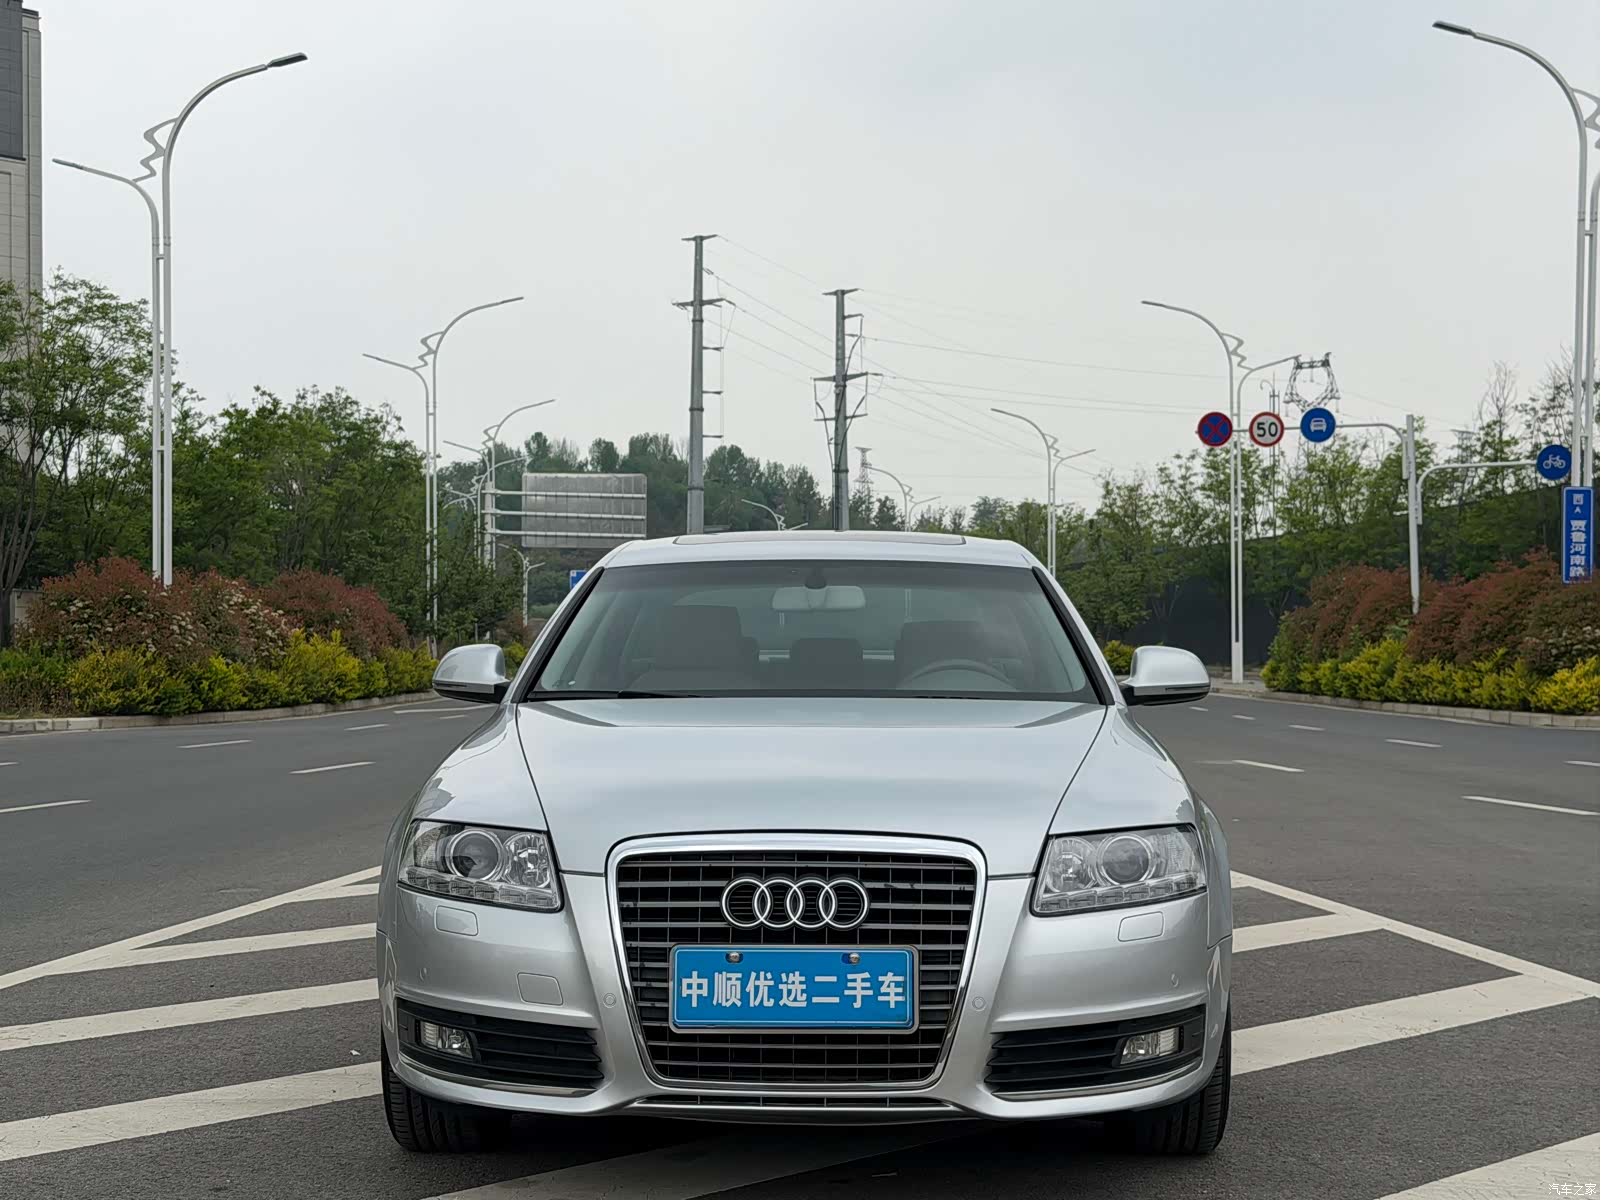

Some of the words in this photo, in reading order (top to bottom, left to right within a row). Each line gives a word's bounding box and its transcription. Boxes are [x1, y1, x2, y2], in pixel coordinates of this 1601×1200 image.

[1257, 422, 1278, 437] 50
[1570, 520, 1587, 577] 贾鲁河南路
[681, 971, 905, 1008] 中顺优选二手车
